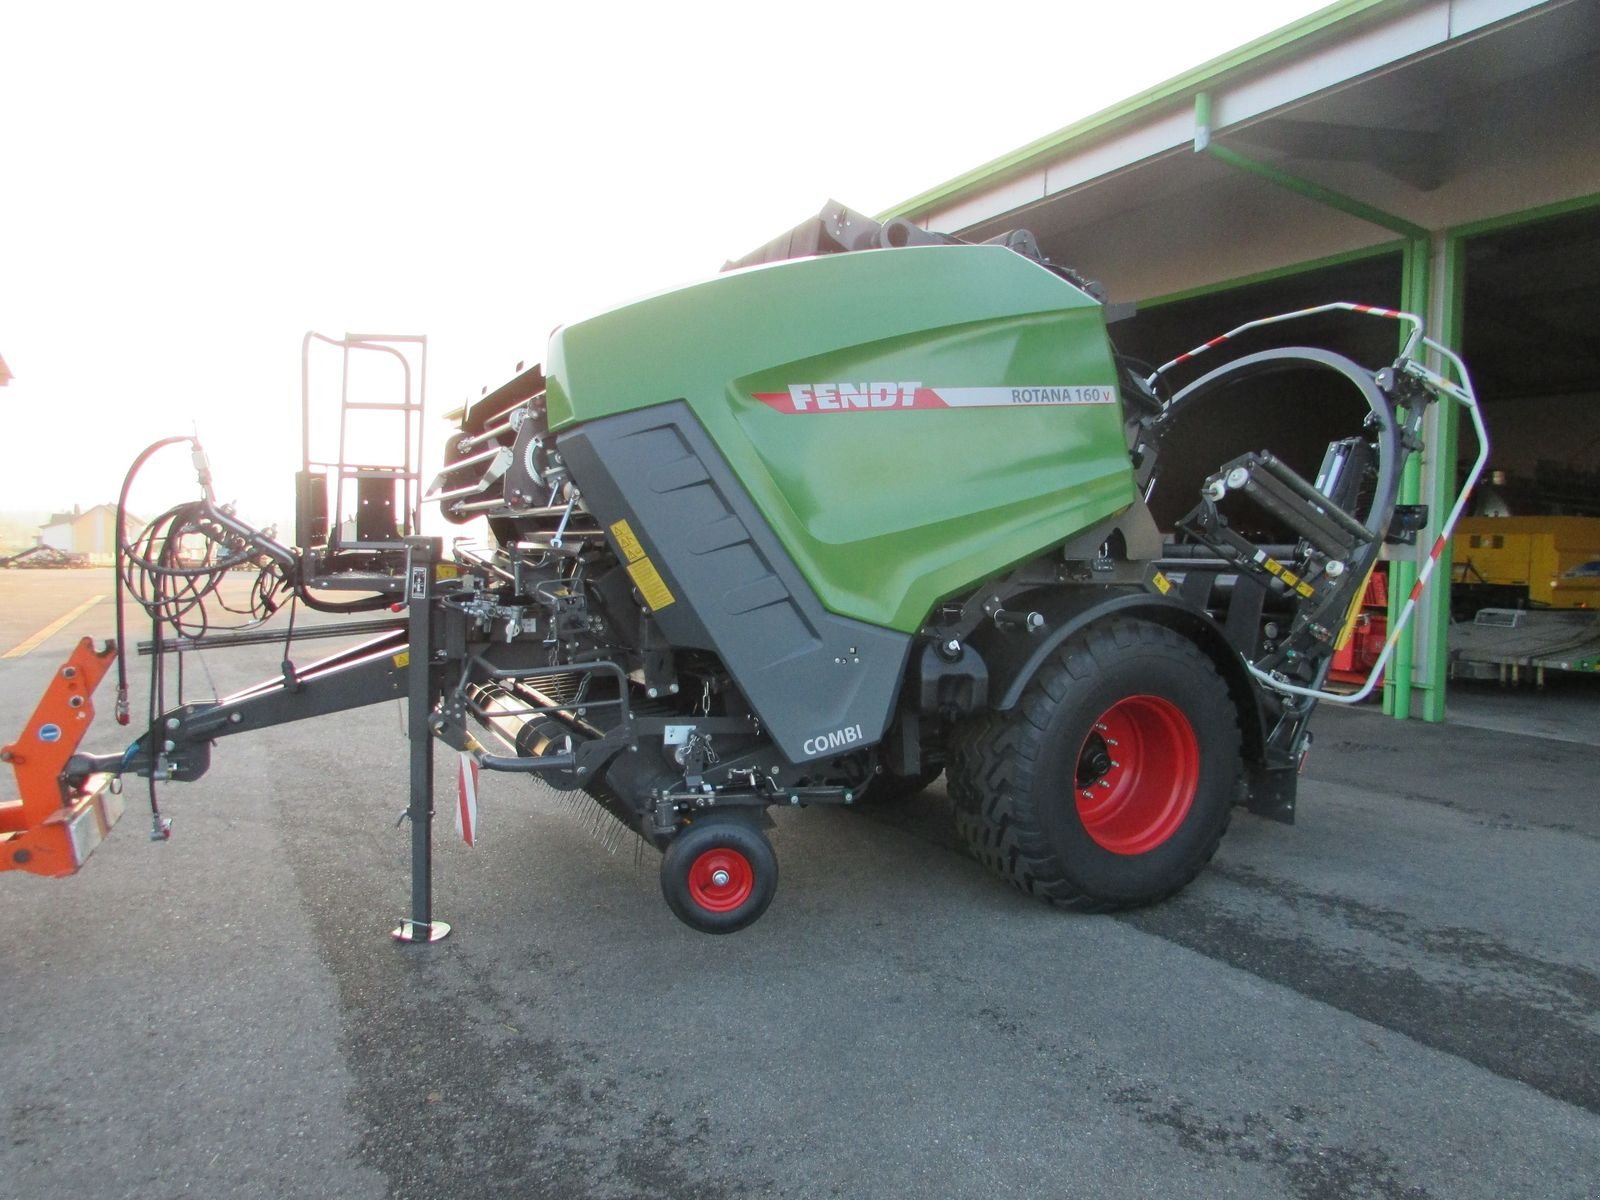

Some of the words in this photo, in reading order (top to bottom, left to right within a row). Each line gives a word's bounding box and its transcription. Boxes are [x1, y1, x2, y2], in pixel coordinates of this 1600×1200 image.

[787, 381, 922, 410] FENDT
[1011, 388, 1072, 403] ROTANA
[1075, 388, 1100, 401] 160
[803, 724, 863, 755] COMBI
